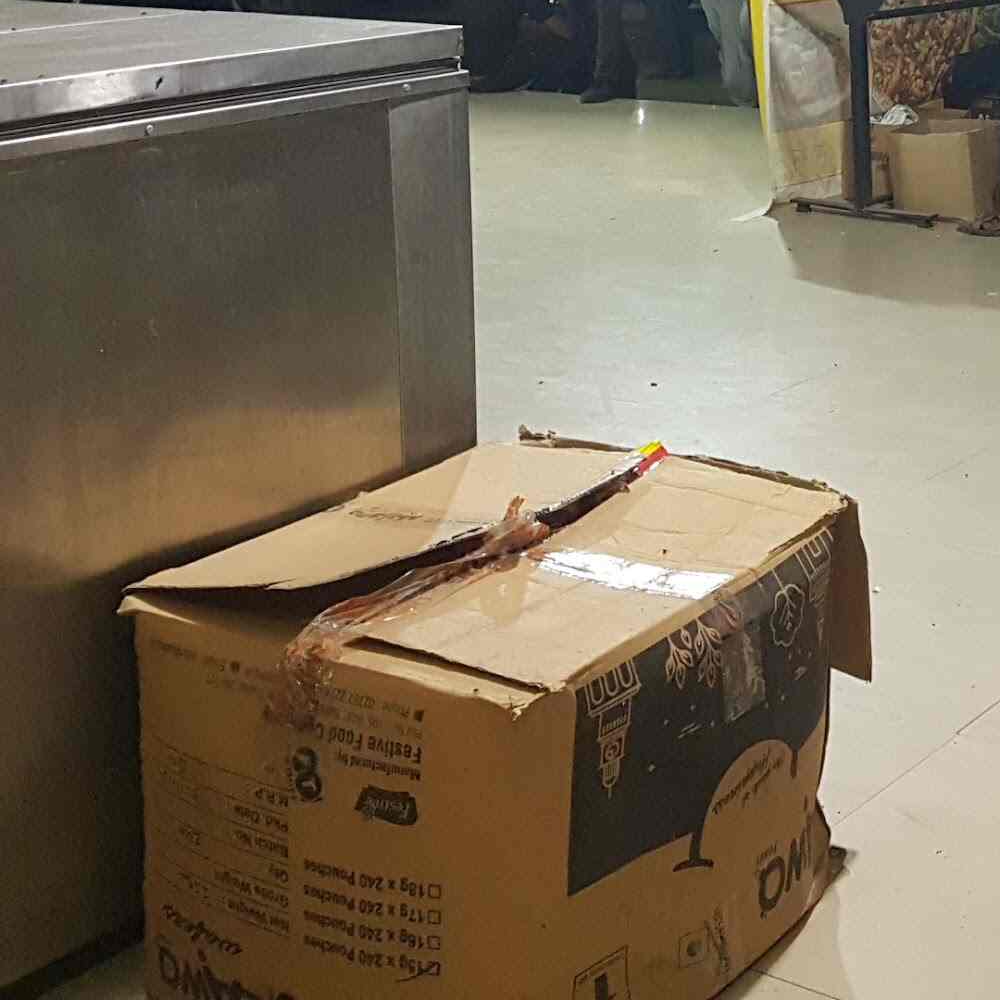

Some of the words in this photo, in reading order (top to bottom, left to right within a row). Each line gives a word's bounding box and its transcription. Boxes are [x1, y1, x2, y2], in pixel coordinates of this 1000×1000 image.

[327, 726, 363, 752] Food
[367, 735, 422, 765] Festive
[303, 858, 355, 887] Pouches
[359, 873, 383, 892] 240
[303, 884, 355, 911] Pouches
[359, 899, 383, 916] 240
[359, 924, 383, 943] 240
[359, 949, 383, 968] 240
